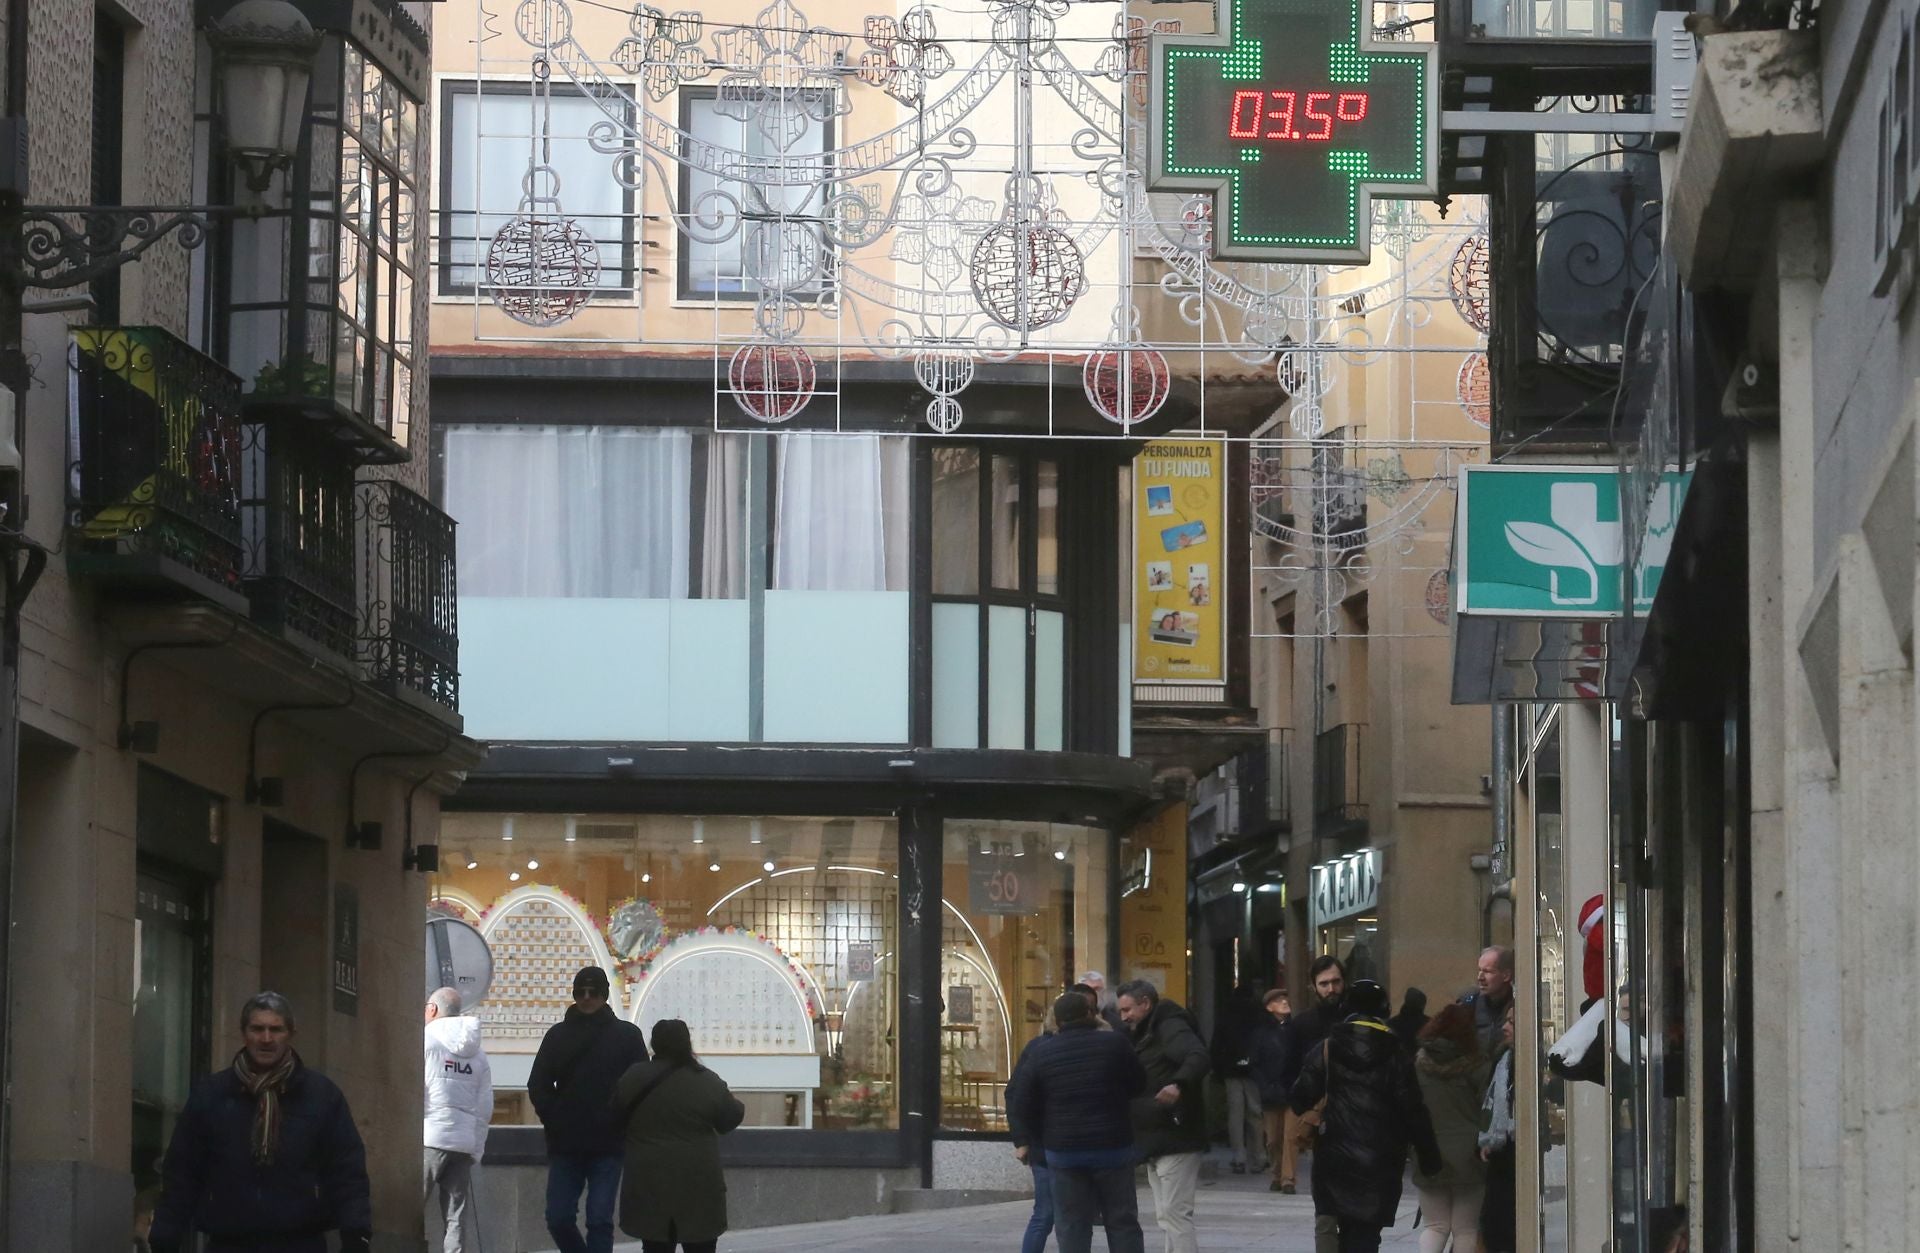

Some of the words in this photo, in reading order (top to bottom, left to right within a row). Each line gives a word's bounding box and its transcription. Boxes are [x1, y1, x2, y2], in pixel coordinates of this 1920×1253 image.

[1143, 446, 1212, 458] PERSONALIZA
[1143, 459, 1162, 477] TU
[1164, 460, 1212, 478] FUNDA
[335, 960, 357, 992] REAL
[444, 1060, 473, 1075] FILA
